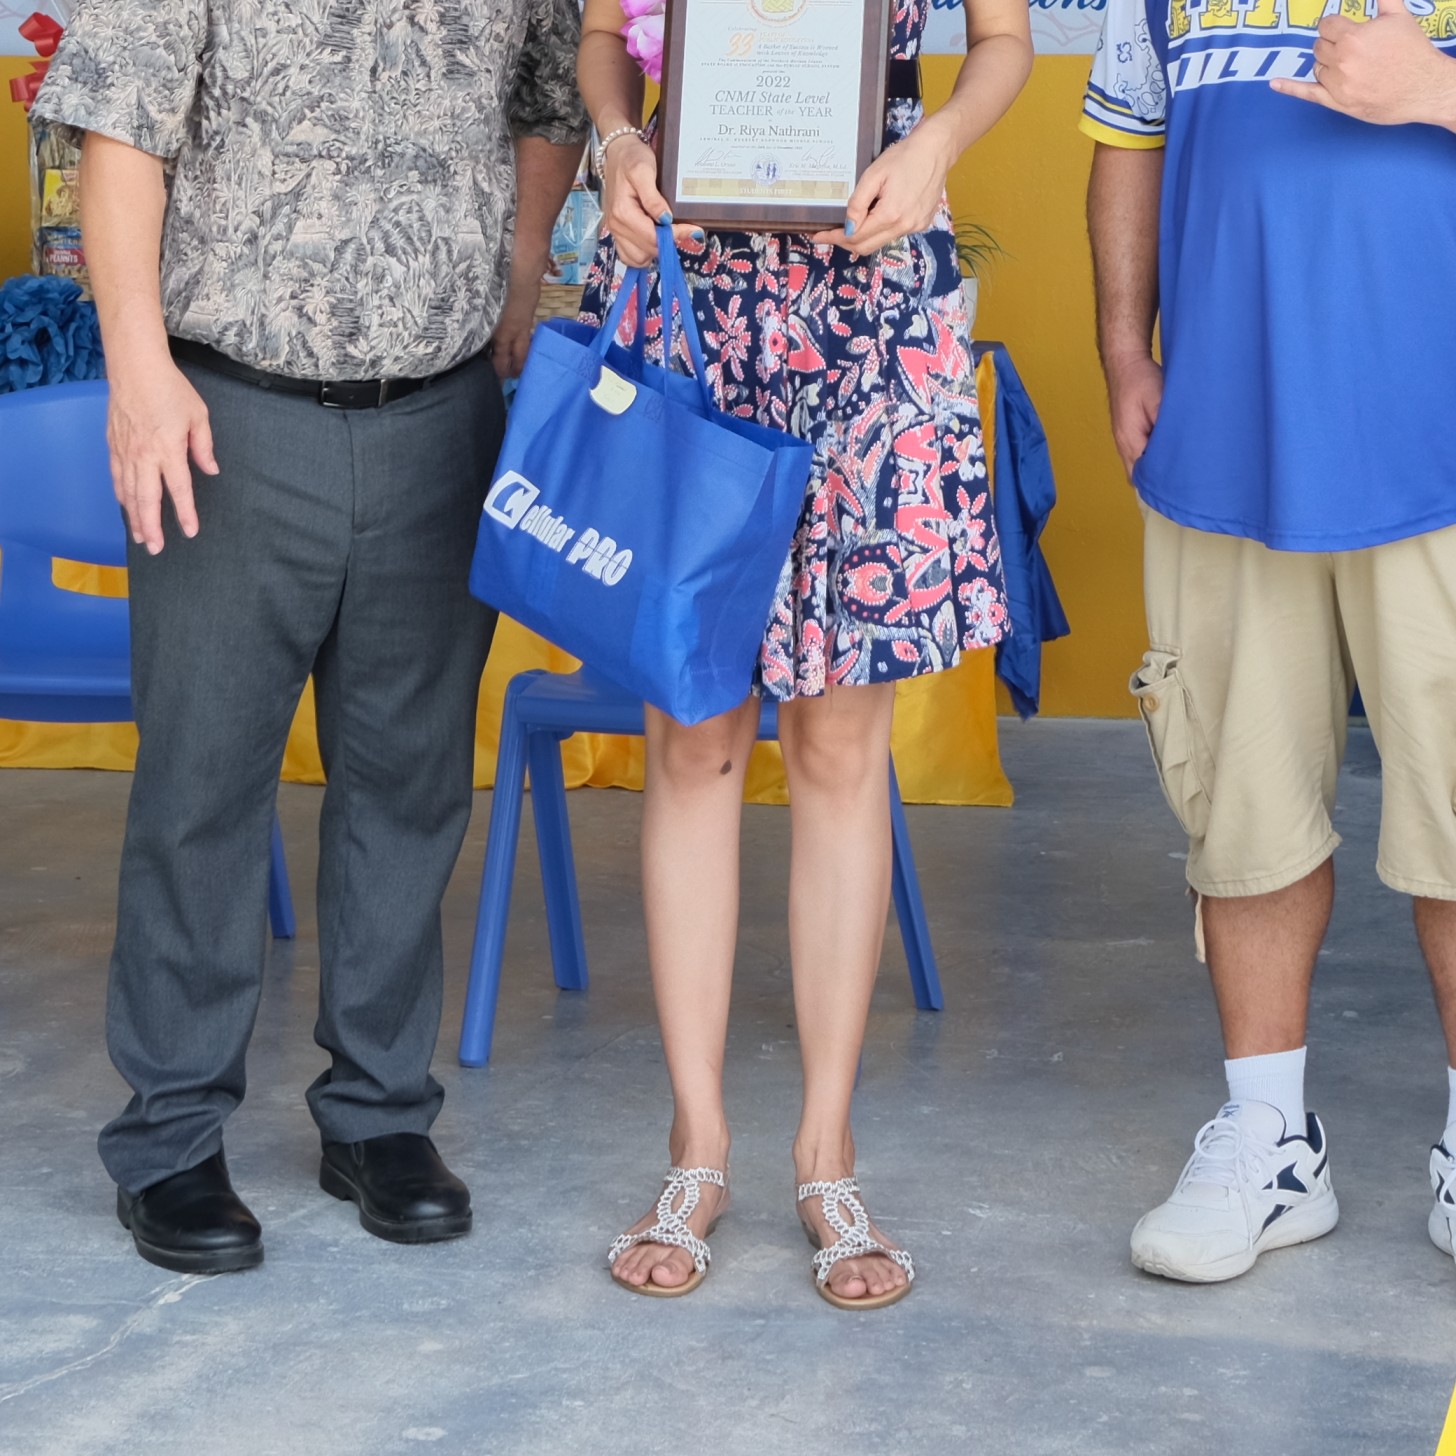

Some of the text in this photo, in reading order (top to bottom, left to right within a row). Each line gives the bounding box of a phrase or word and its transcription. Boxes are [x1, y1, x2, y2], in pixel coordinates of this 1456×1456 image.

[756, 75, 791, 87] 2022
[715, 90, 830, 104] CNMI State Level
[710, 105, 773, 116] TEACHER
[799, 107, 832, 117] YEAR
[719, 124, 820, 138] Dr. Riya Nathrani
[49, 254, 78, 263] PEANUTS
[565, 528, 633, 586] PRO
